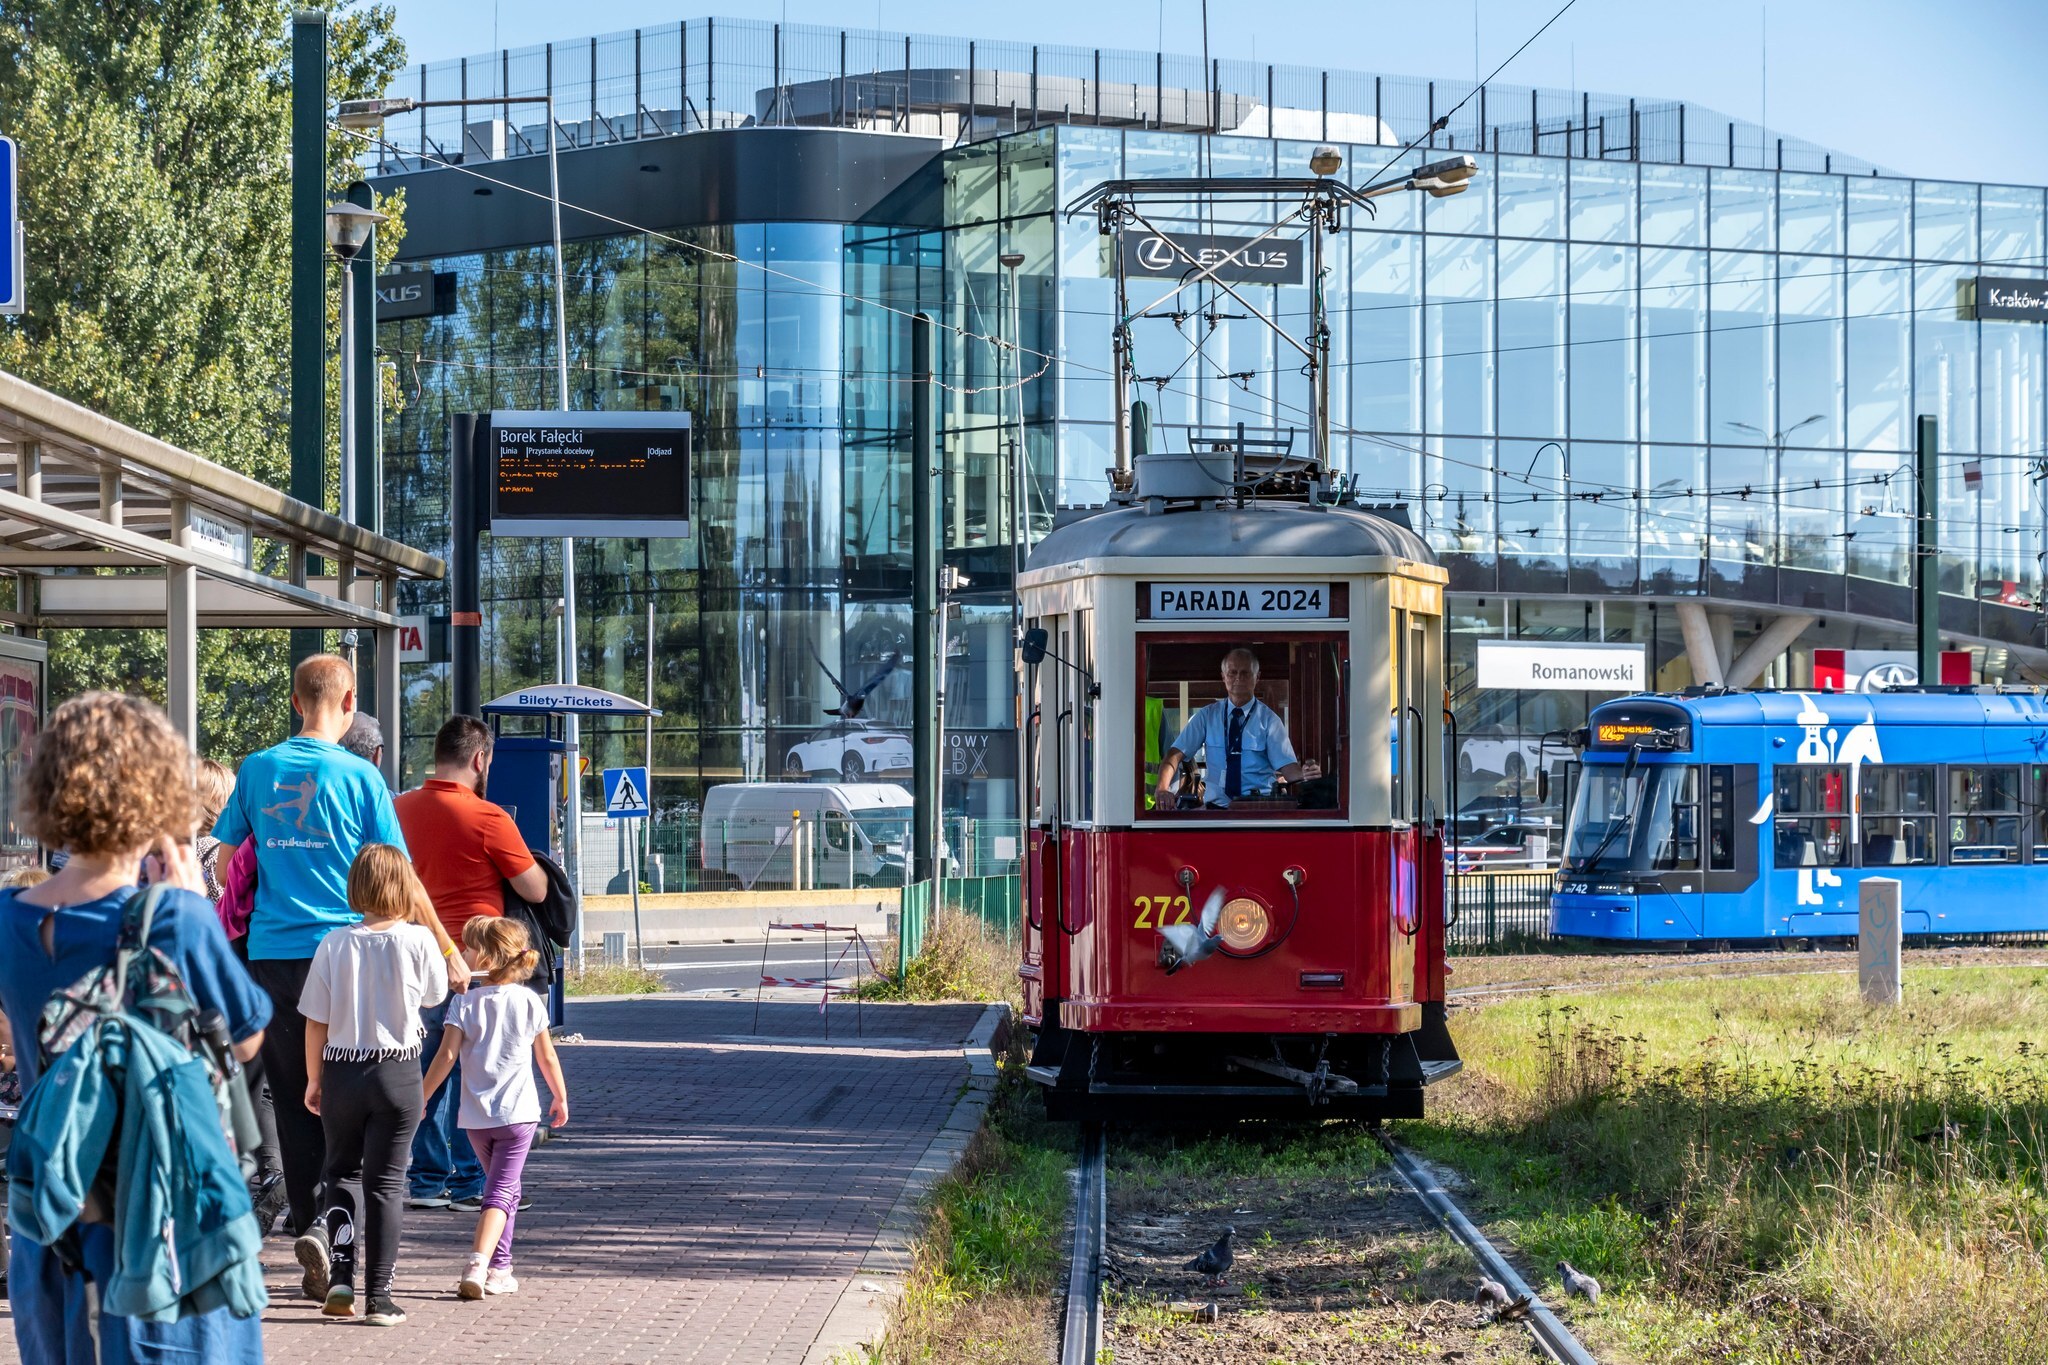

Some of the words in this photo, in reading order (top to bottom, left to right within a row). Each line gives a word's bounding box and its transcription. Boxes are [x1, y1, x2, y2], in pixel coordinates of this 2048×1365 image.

[1178, 247, 1288, 268] LEXUS
[500, 430, 536, 443] Borek
[540, 429, 583, 446] Fałęcki
[502, 447, 518, 455] Linia
[528, 447, 563, 457] Przystanek
[563, 447, 595, 456] docelowy
[650, 447, 672, 457] Odjazd
[1160, 590, 1250, 611] PARADA
[1261, 589, 1322, 611] 2024
[1531, 663, 1634, 681] Romanowski
[519, 694, 613, 708] Bilety-Tickets
[1134, 895, 1192, 929] 272
